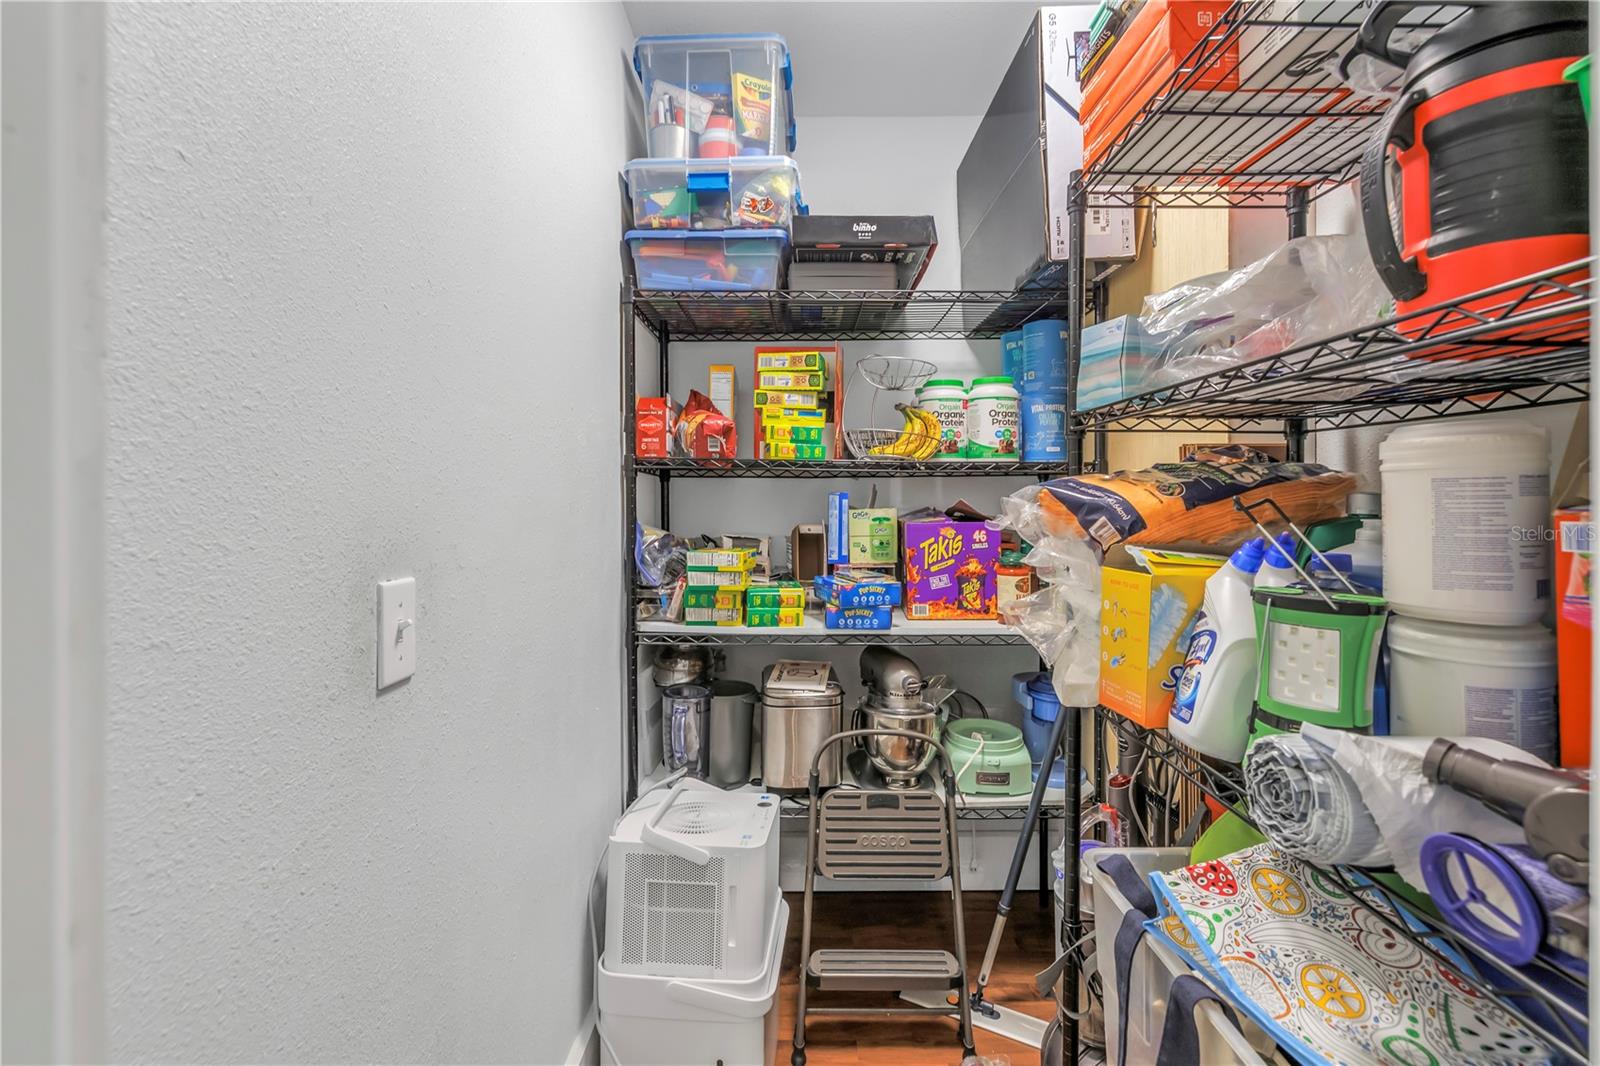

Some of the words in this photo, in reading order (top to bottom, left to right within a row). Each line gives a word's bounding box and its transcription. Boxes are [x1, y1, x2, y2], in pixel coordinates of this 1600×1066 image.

[853, 223, 877, 232] binho
[972, 529, 988, 543] 46
[919, 534, 963, 570] Takis
[961, 579, 981, 596] Takis
[860, 834, 906, 848] COSCO
